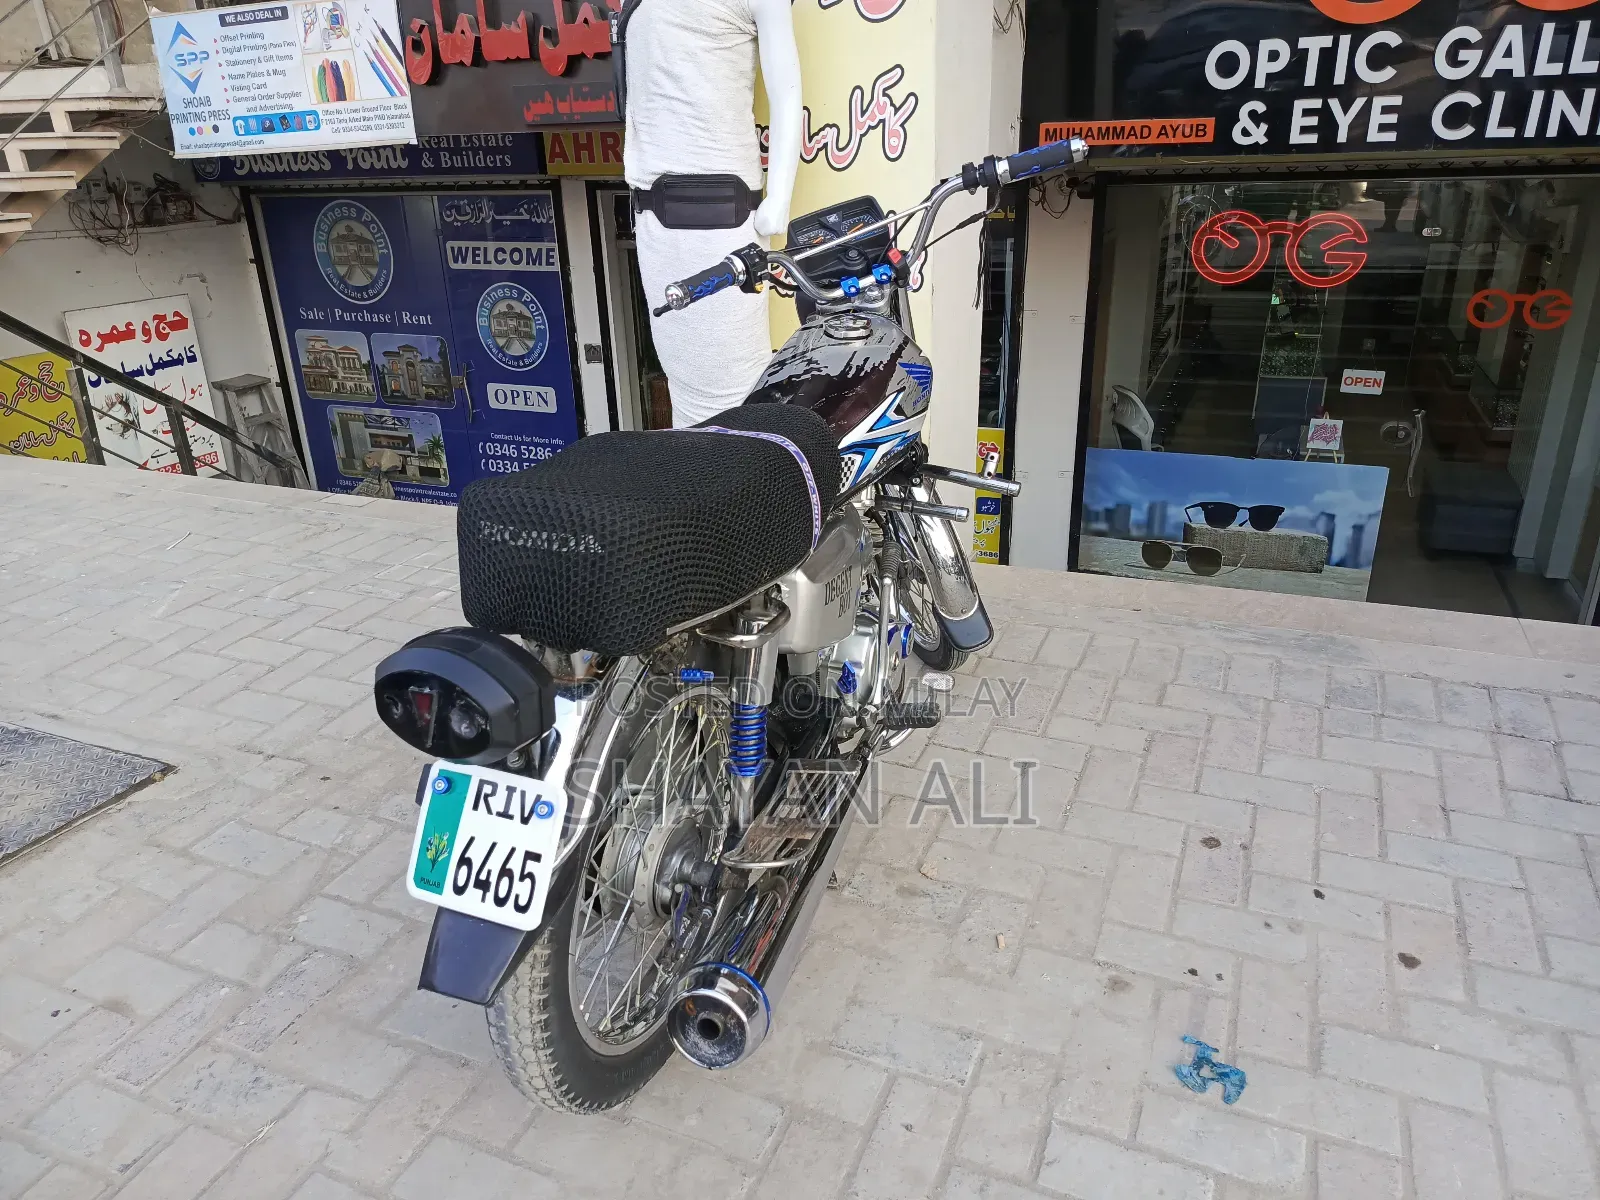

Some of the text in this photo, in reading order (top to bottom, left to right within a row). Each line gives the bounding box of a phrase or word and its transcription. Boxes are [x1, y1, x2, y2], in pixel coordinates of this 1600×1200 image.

[225, 8, 282, 23] WE ALSO DEAL IN
[220, 32, 265, 43] Offset Printing
[222, 45, 243, 56] Digital
[243, 43, 268, 52] Printing
[174, 50, 210, 68] SPP
[225, 54, 294, 67] Stationery & Gift Items
[1205, 30, 1403, 90] OPTIC
[228, 68, 286, 81] Name Plates & Mug
[251, 82, 268, 90] Card
[183, 95, 212, 109] SHOAIB
[232, 90, 302, 103] General Order Supplier
[170, 108, 231, 125] PRINTING PRESS
[246, 105, 258, 113] and
[347, 106, 360, 115] Lower
[362, 104, 379, 113] Ground
[393, 102, 408, 110] Block
[1231, 88, 1600, 146] & EYE CLIN
[418, 133, 513, 149] Real Estate
[1044, 123, 1208, 142] MUHAMMAD AYUB
[229, 150, 331, 175] Business
[339, 143, 409, 170] Point
[421, 150, 513, 168] & Builders
[316, 206, 389, 254] Business Point
[450, 246, 556, 267] WELCOME
[326, 267, 387, 299] Real Estate & Builders
[299, 306, 325, 320] Sale
[334, 308, 391, 323] Purchase
[401, 311, 433, 325] Rent
[479, 287, 545, 330] Business Point
[152, 310, 188, 342] حج
[78, 321, 136, 353] عمرہ
[486, 339, 499, 355] Real
[498, 352, 518, 367] Estate
[523, 342, 543, 365] Builders
[1343, 376, 1383, 388] OPEN
[494, 388, 549, 408] OPEN
[490, 432, 565, 446] Contact Us for More Info:
[485, 442, 553, 460] 0346 5286
[488, 459, 520, 473] 0334
[471, 778, 543, 826] RIV
[419, 876, 441, 889] PUNJAB
[452, 836, 543, 915] 6465
